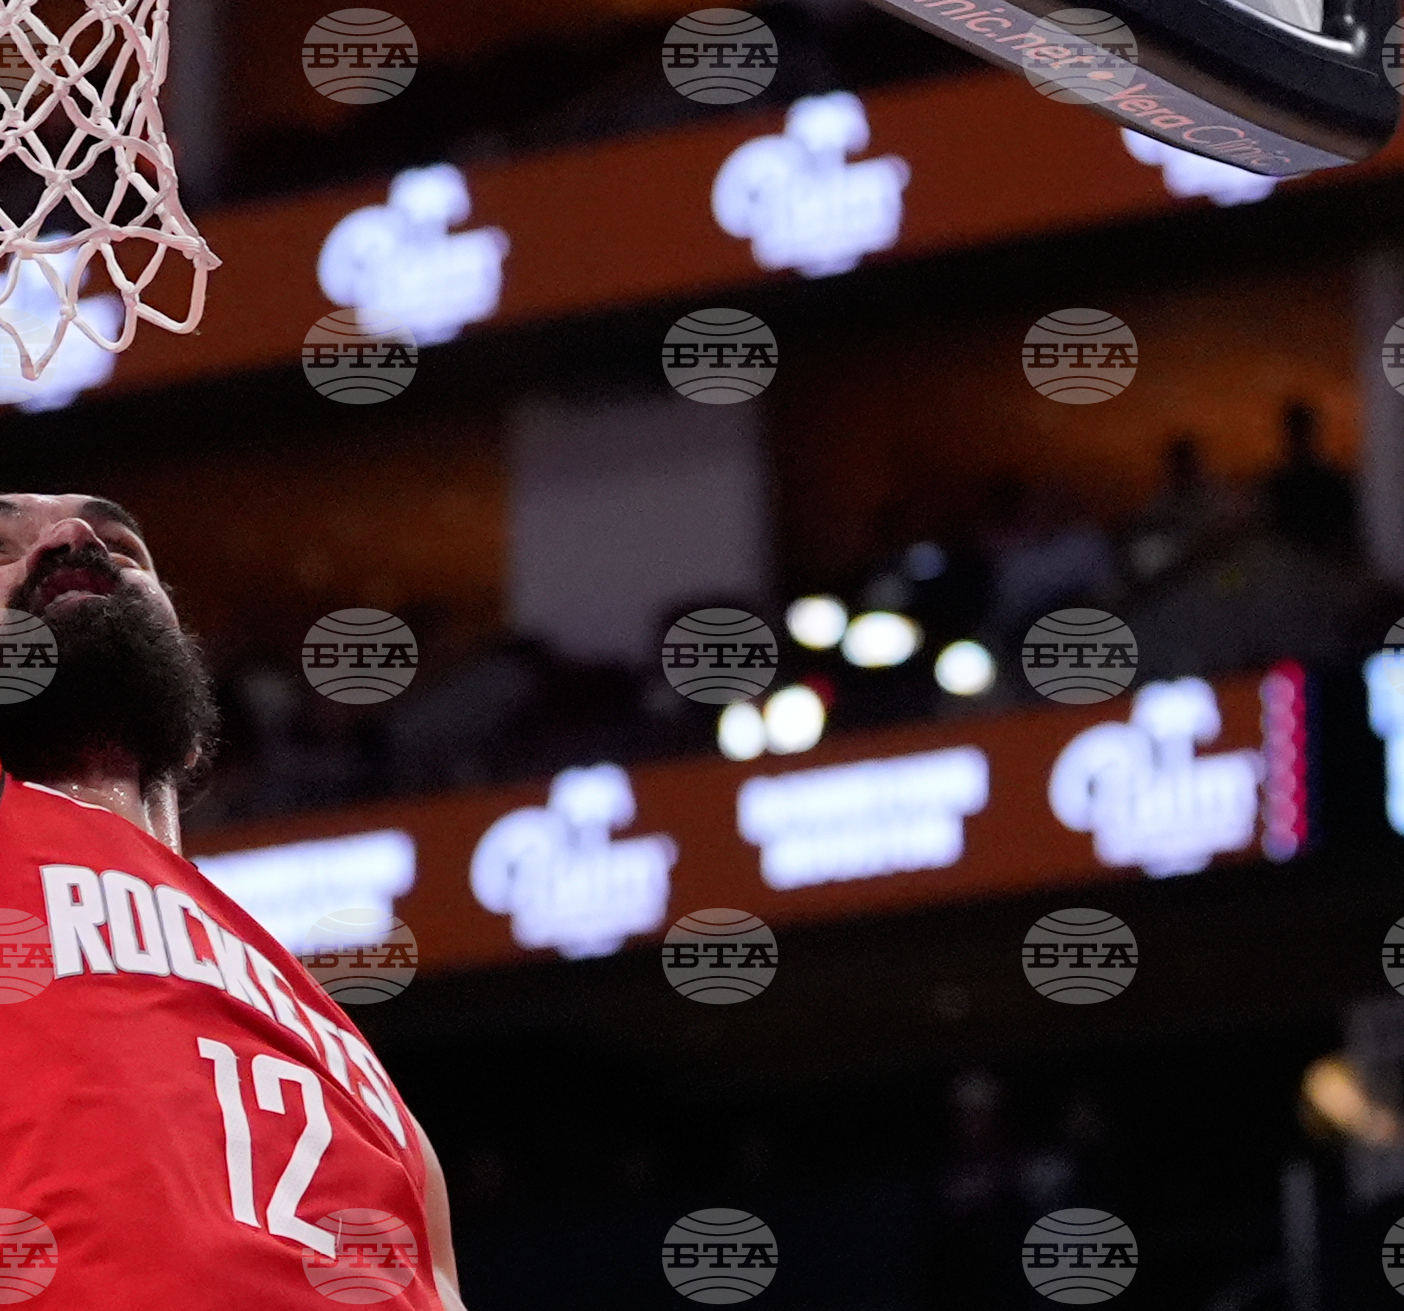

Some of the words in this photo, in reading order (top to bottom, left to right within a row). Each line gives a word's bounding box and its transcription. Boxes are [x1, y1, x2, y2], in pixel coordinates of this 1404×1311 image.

[1105, 83, 1195, 130] Vera
[39, 863, 407, 1149] ROCKETS
[197, 1036, 337, 1260] 12
